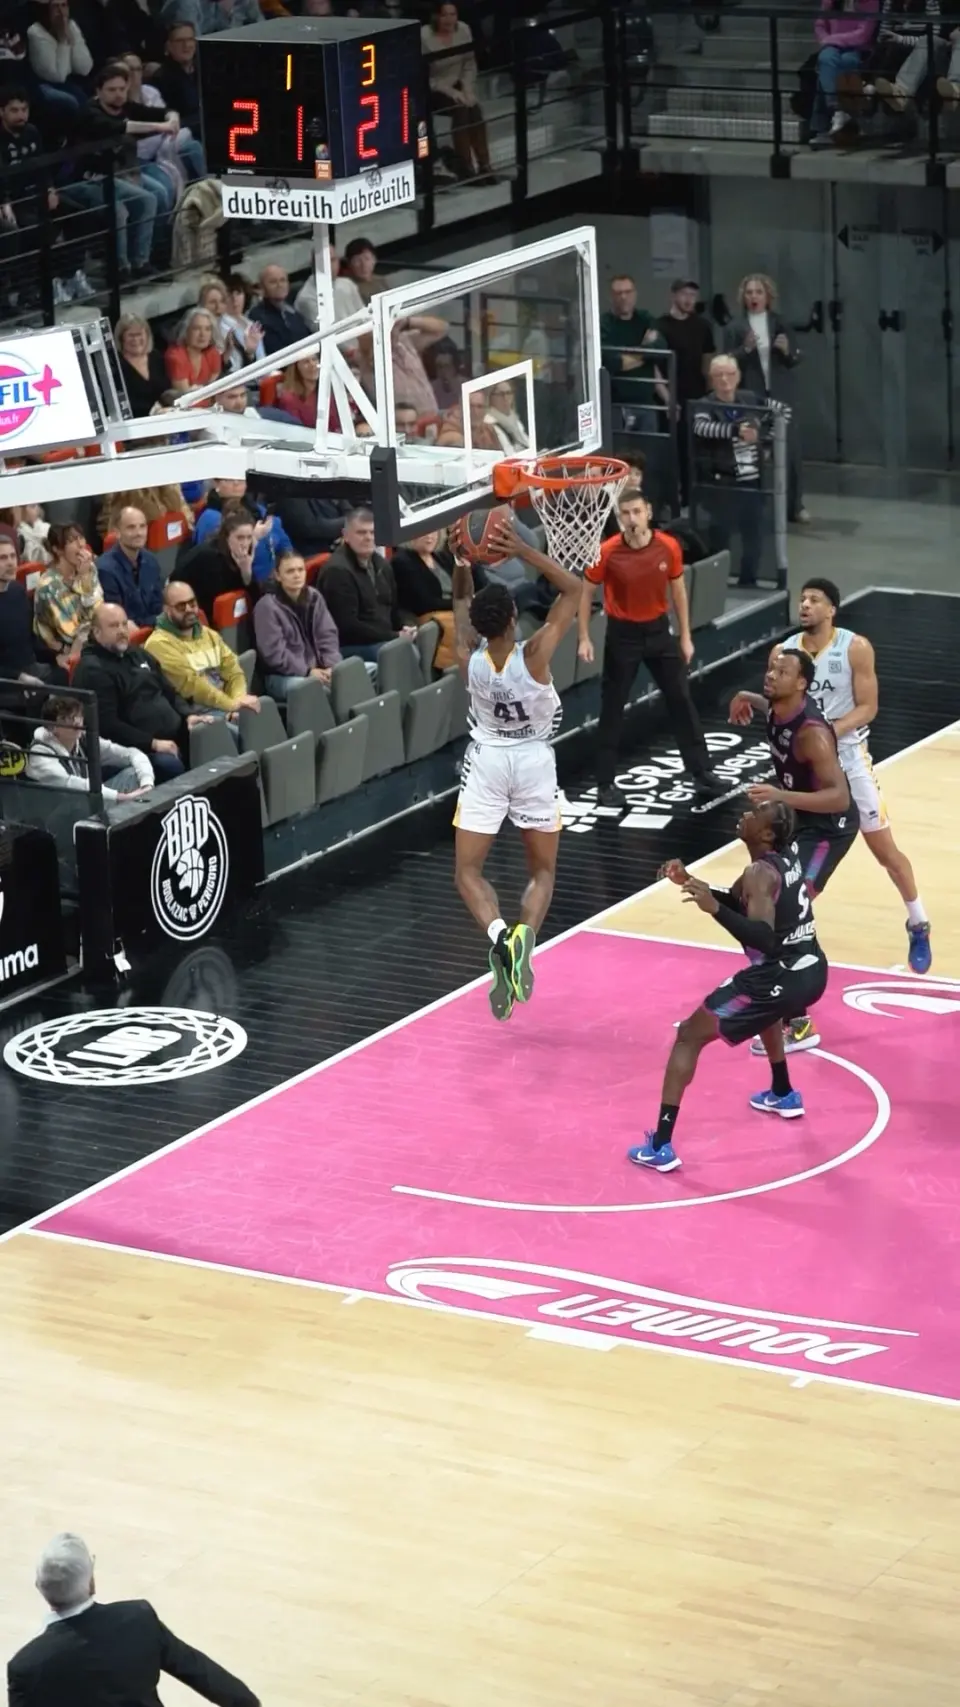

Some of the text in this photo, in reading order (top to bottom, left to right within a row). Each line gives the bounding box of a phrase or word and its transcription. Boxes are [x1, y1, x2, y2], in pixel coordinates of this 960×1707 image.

[286, 53, 292, 91] 1
[361, 44, 376, 86] 3
[227, 191, 333, 219] dubreuilh
[340, 175, 411, 217] dubreuilh
[494, 701, 530, 723] 41
[614, 732, 742, 790] GRAD
[166, 800, 209, 870] BBD
[162, 878, 188, 922] BOULAZAC
[197, 855, 217, 914] PERIGORD
[798, 882, 810, 920] 5
[769, 985, 783, 997] 5
[66, 1025, 182, 1067] LNB
[537, 1293, 890, 1366] DOUMEN
